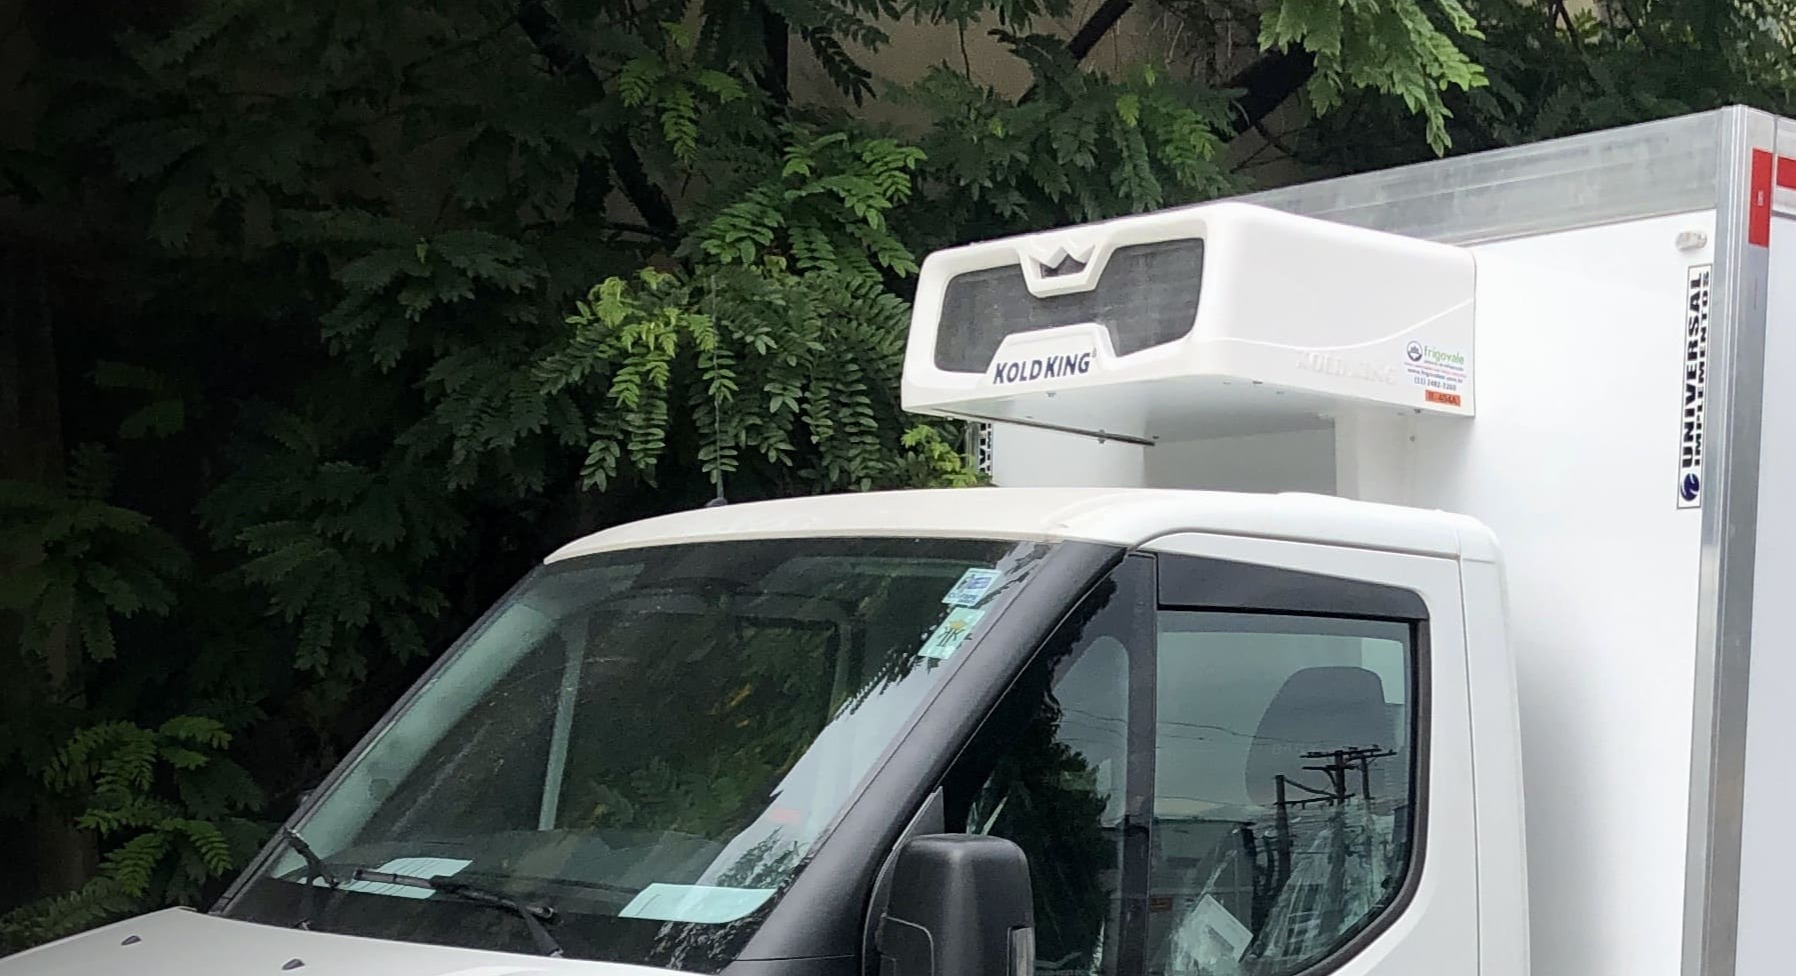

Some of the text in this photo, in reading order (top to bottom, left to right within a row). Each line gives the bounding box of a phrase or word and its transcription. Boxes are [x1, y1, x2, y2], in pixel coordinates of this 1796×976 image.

[1424, 346, 1465, 365] frigovale
[1682, 272, 1701, 468] UNIVERSAL
[1694, 271, 1709, 466] IMPLEMENTOS
